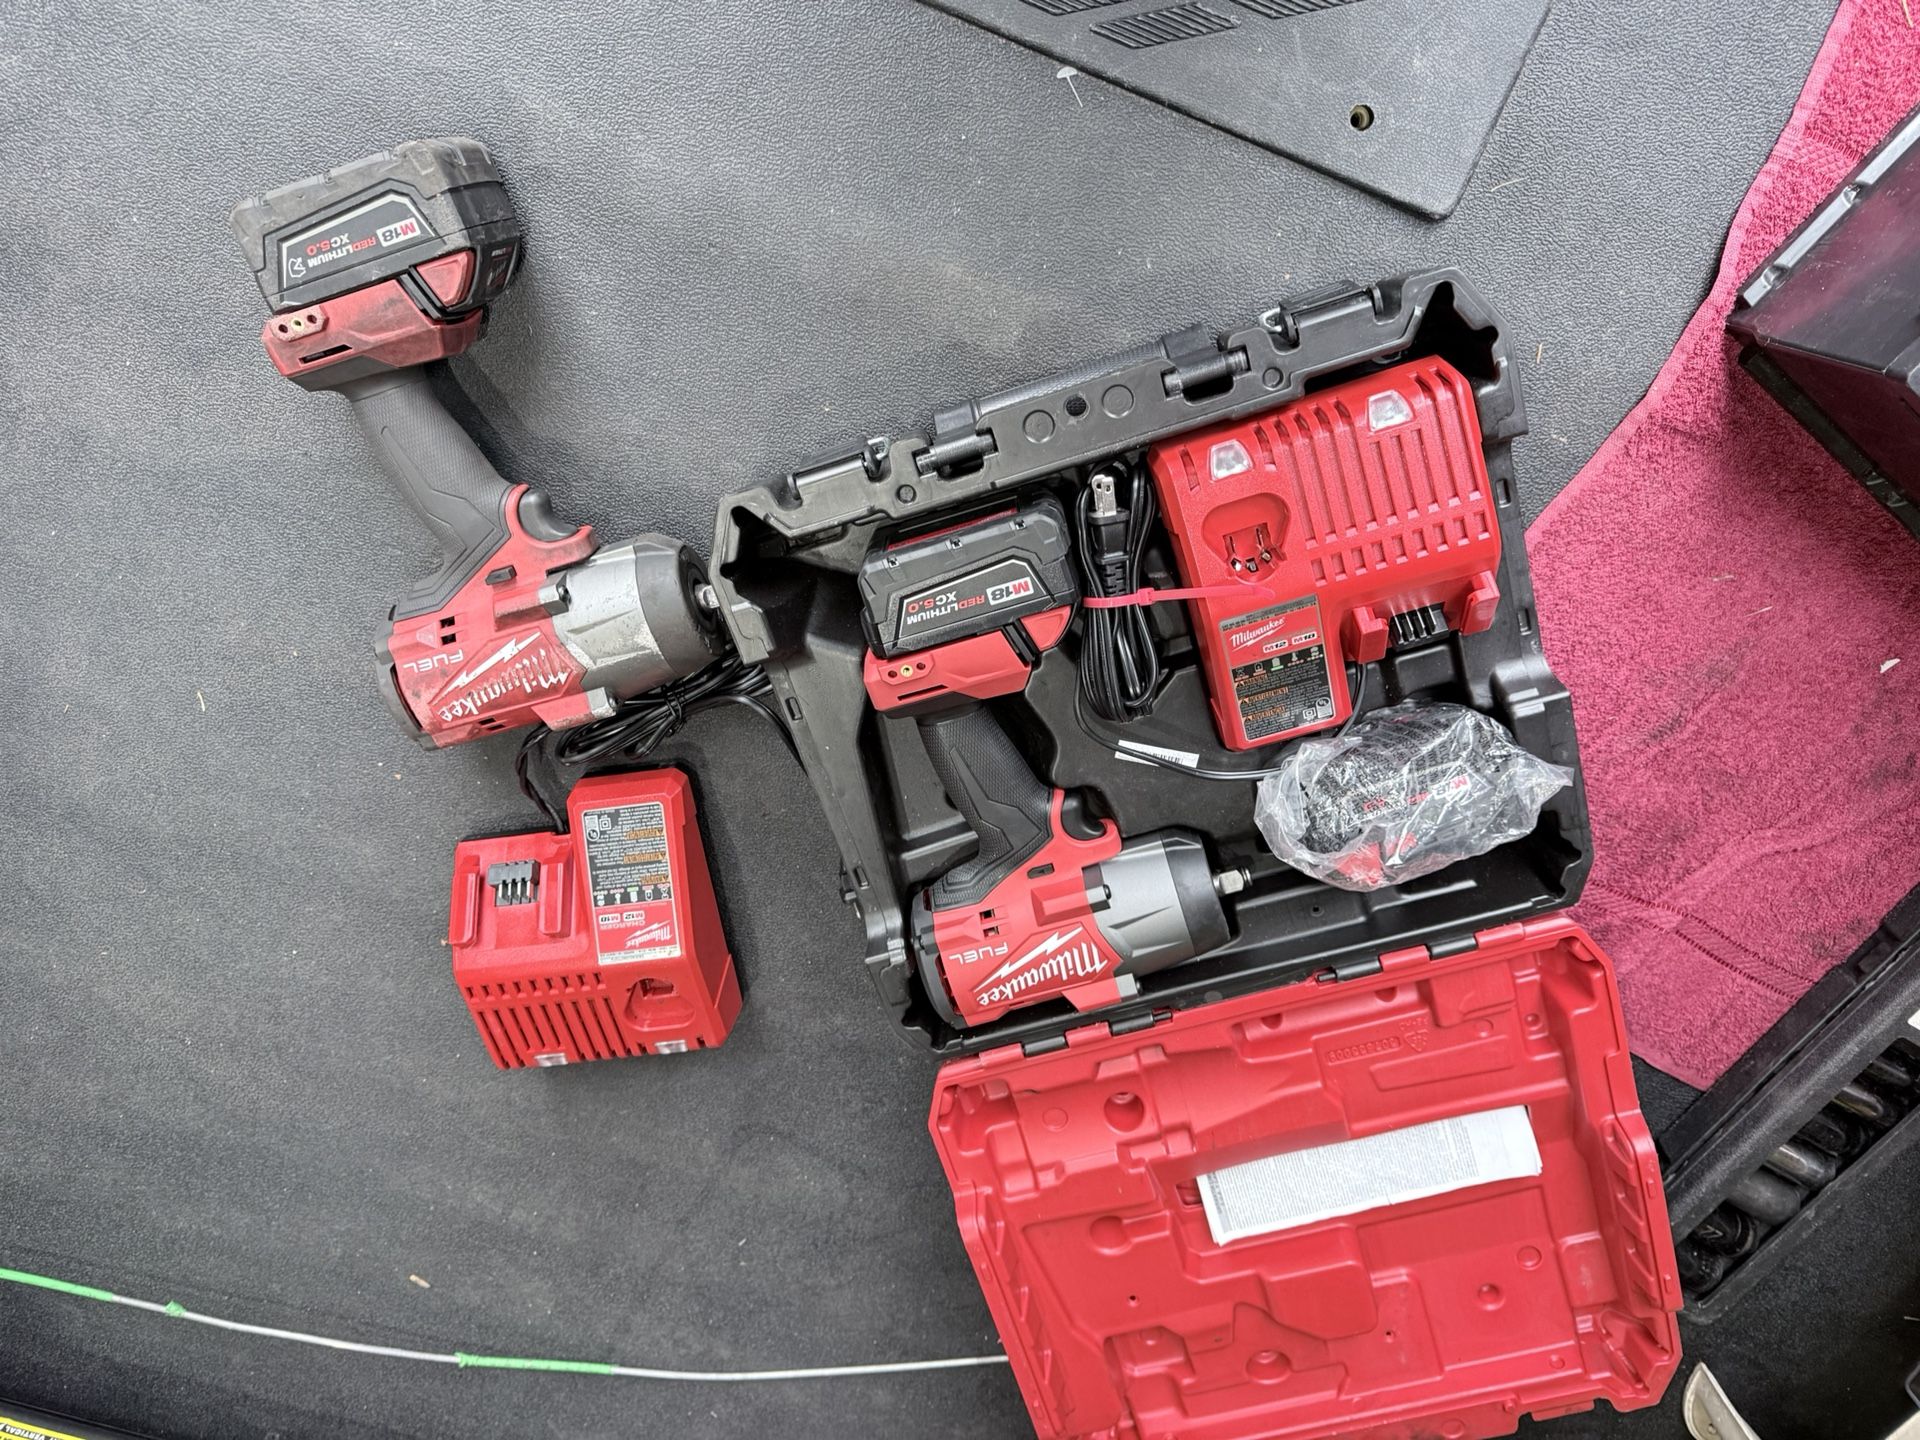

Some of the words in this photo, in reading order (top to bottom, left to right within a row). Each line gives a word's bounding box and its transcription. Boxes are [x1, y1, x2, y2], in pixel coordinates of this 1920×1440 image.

[305, 231, 350, 255] XC5.0
[380, 220, 417, 244] M18
[307, 235, 377, 267] REDLITHIUM
[907, 590, 957, 612] XC5.0
[990, 580, 1031, 602] M18
[906, 594, 986, 625] REDLITHIUM
[1230, 616, 1286, 648] Milwaukee
[402, 648, 464, 673] FUEL
[623, 926, 672, 947] Milwaukee
[948, 941, 1009, 965] FUEL
[975, 941, 1108, 1008] Milwaukee
